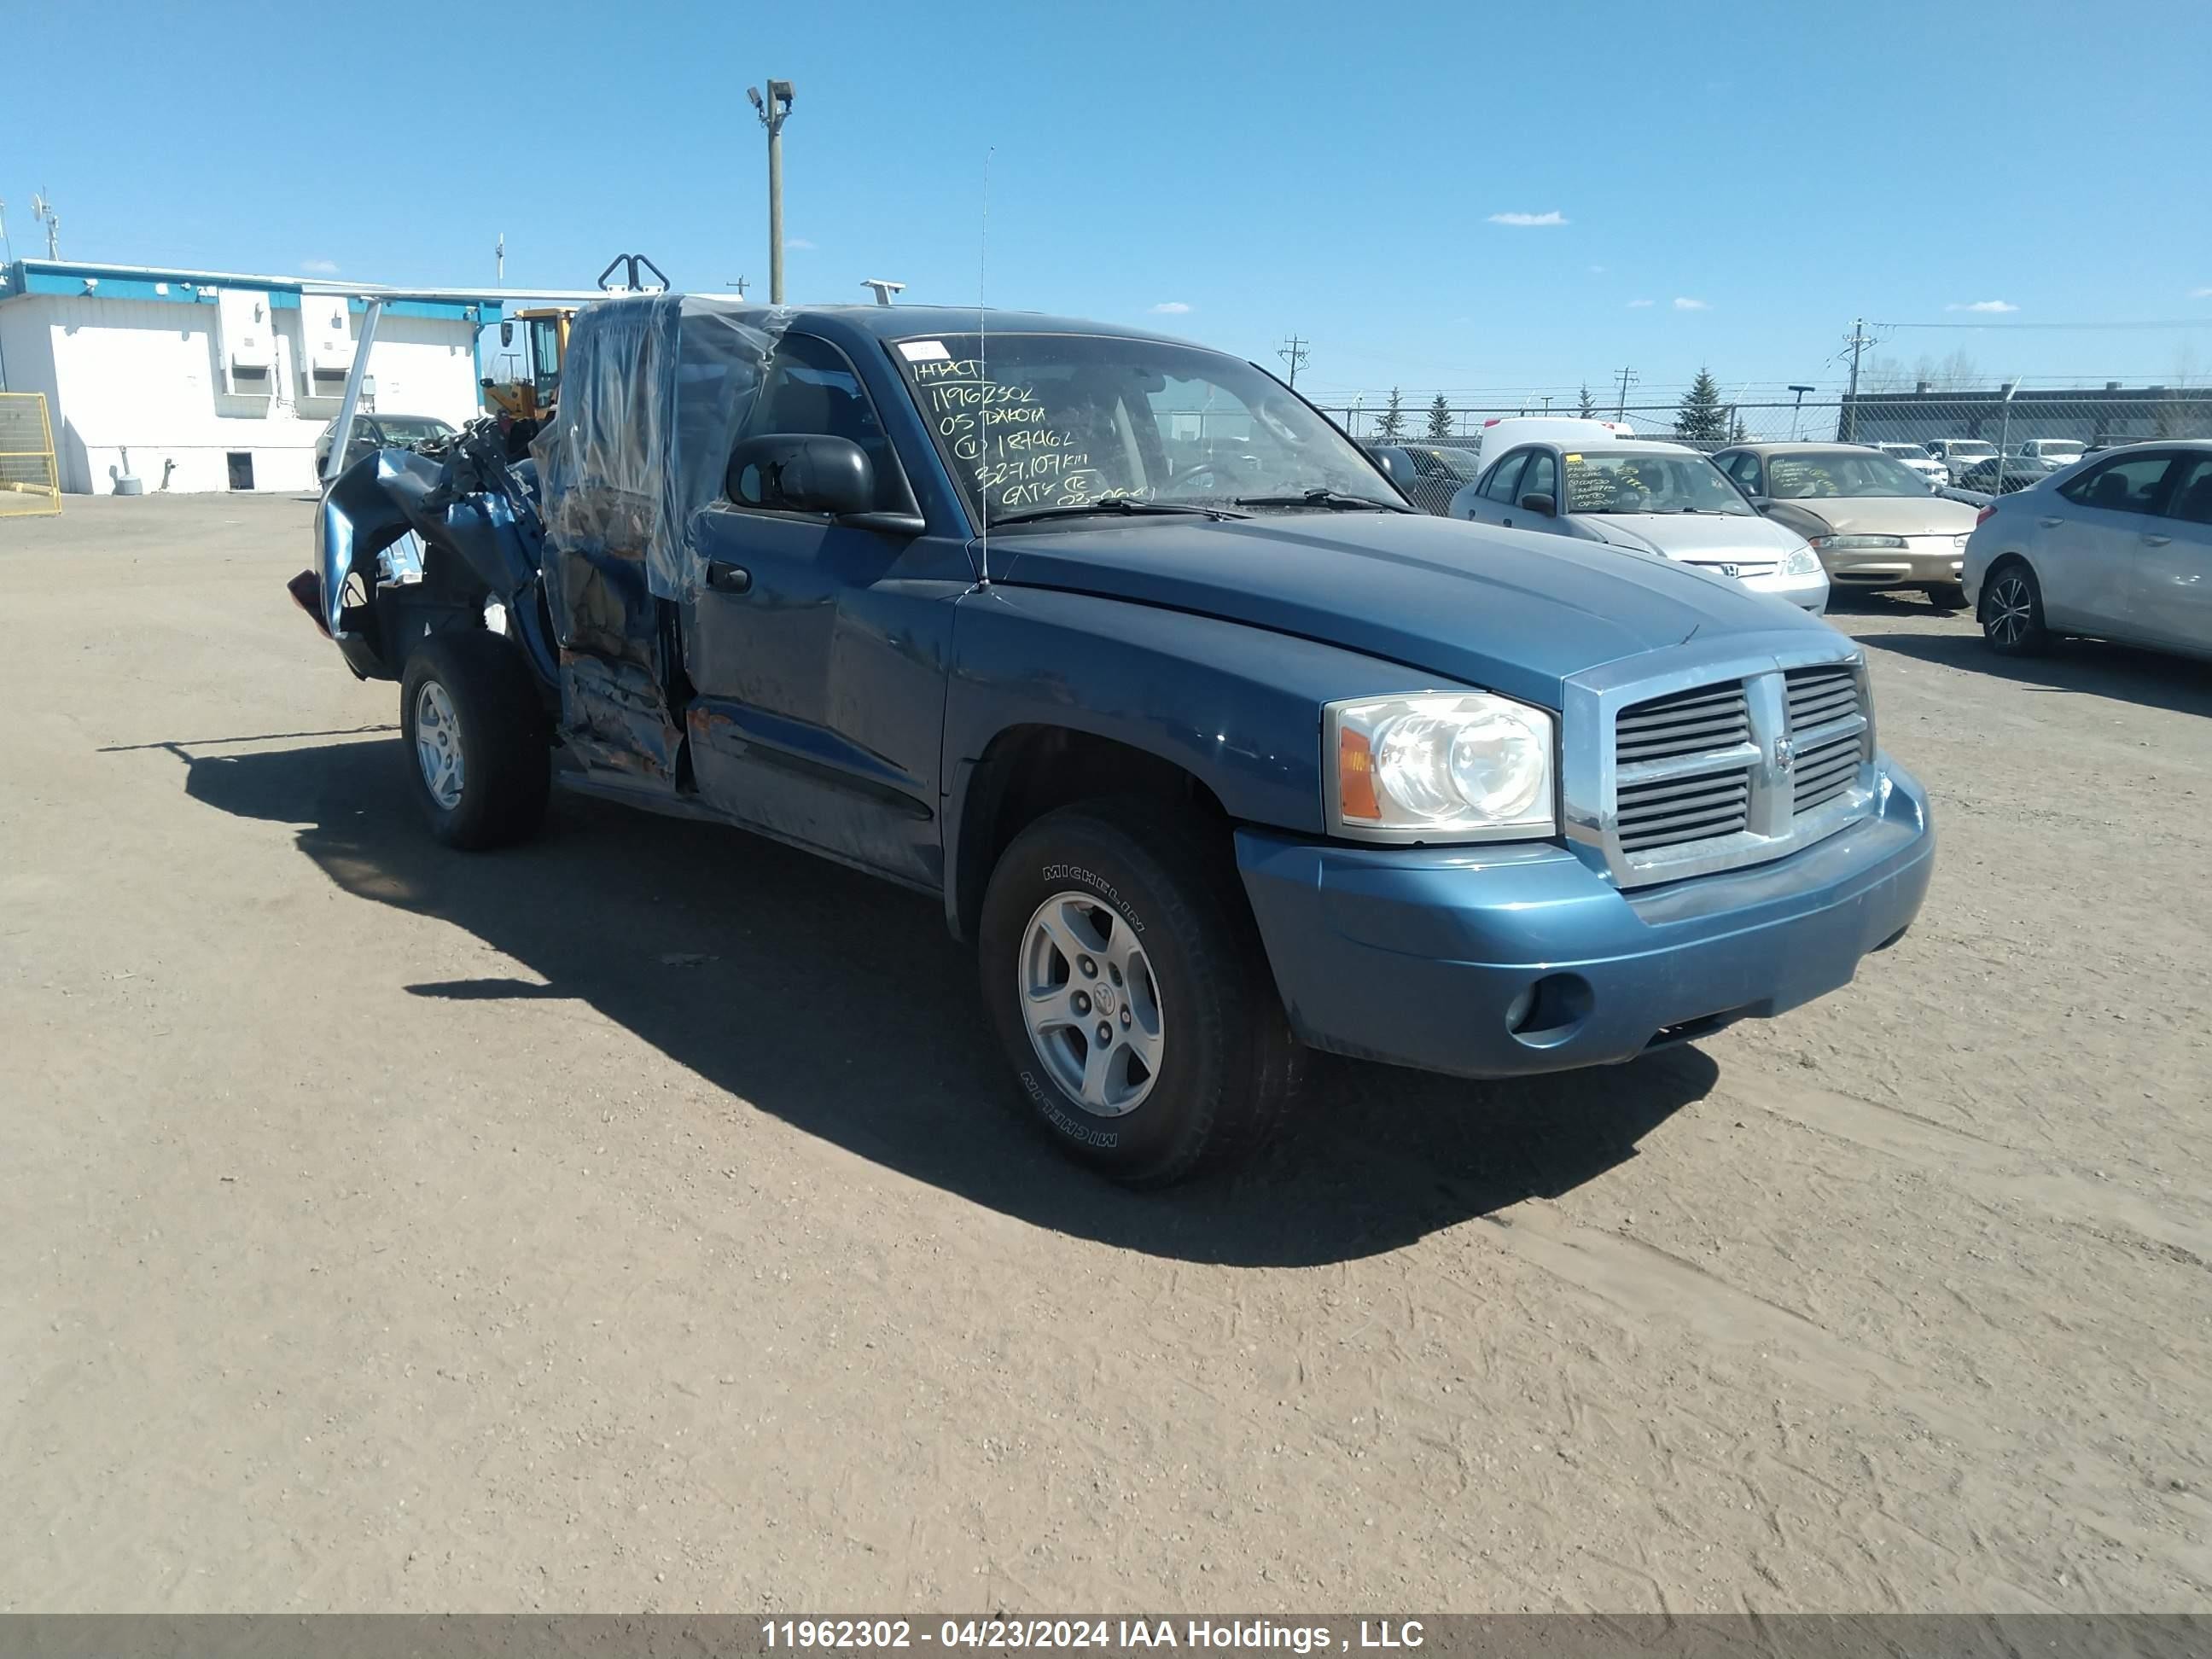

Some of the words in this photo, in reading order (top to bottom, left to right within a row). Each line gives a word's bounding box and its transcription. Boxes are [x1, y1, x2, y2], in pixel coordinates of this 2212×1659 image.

[940, 413, 975, 436] 05
[979, 406, 1046, 426] DAKOTA
[1042, 864, 1146, 934] MICHELIN
[1021, 1071, 1119, 1148] MICHELIN
